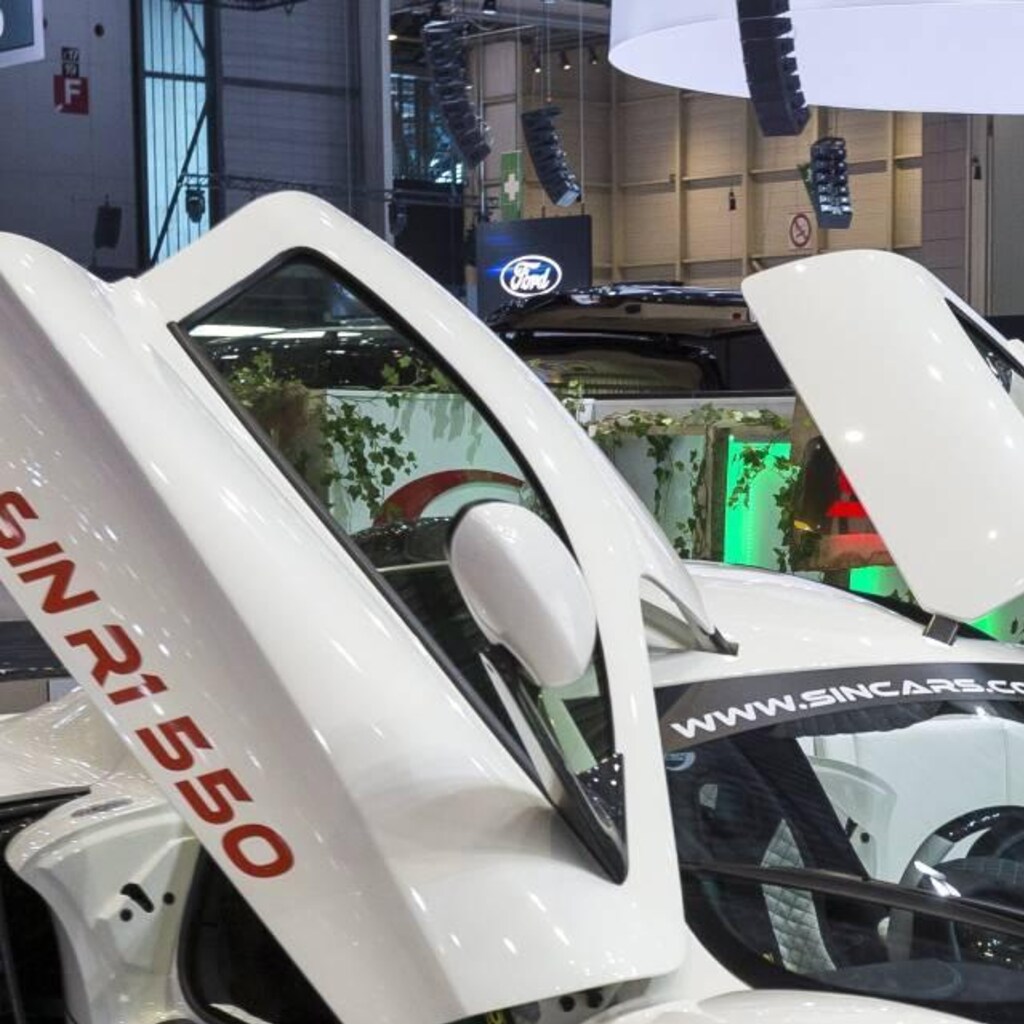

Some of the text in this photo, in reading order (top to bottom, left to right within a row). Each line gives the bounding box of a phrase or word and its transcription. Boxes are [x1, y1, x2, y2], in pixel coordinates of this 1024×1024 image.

[510, 261, 552, 291] Ford
[0, 490, 295, 878] SIN R1 550
